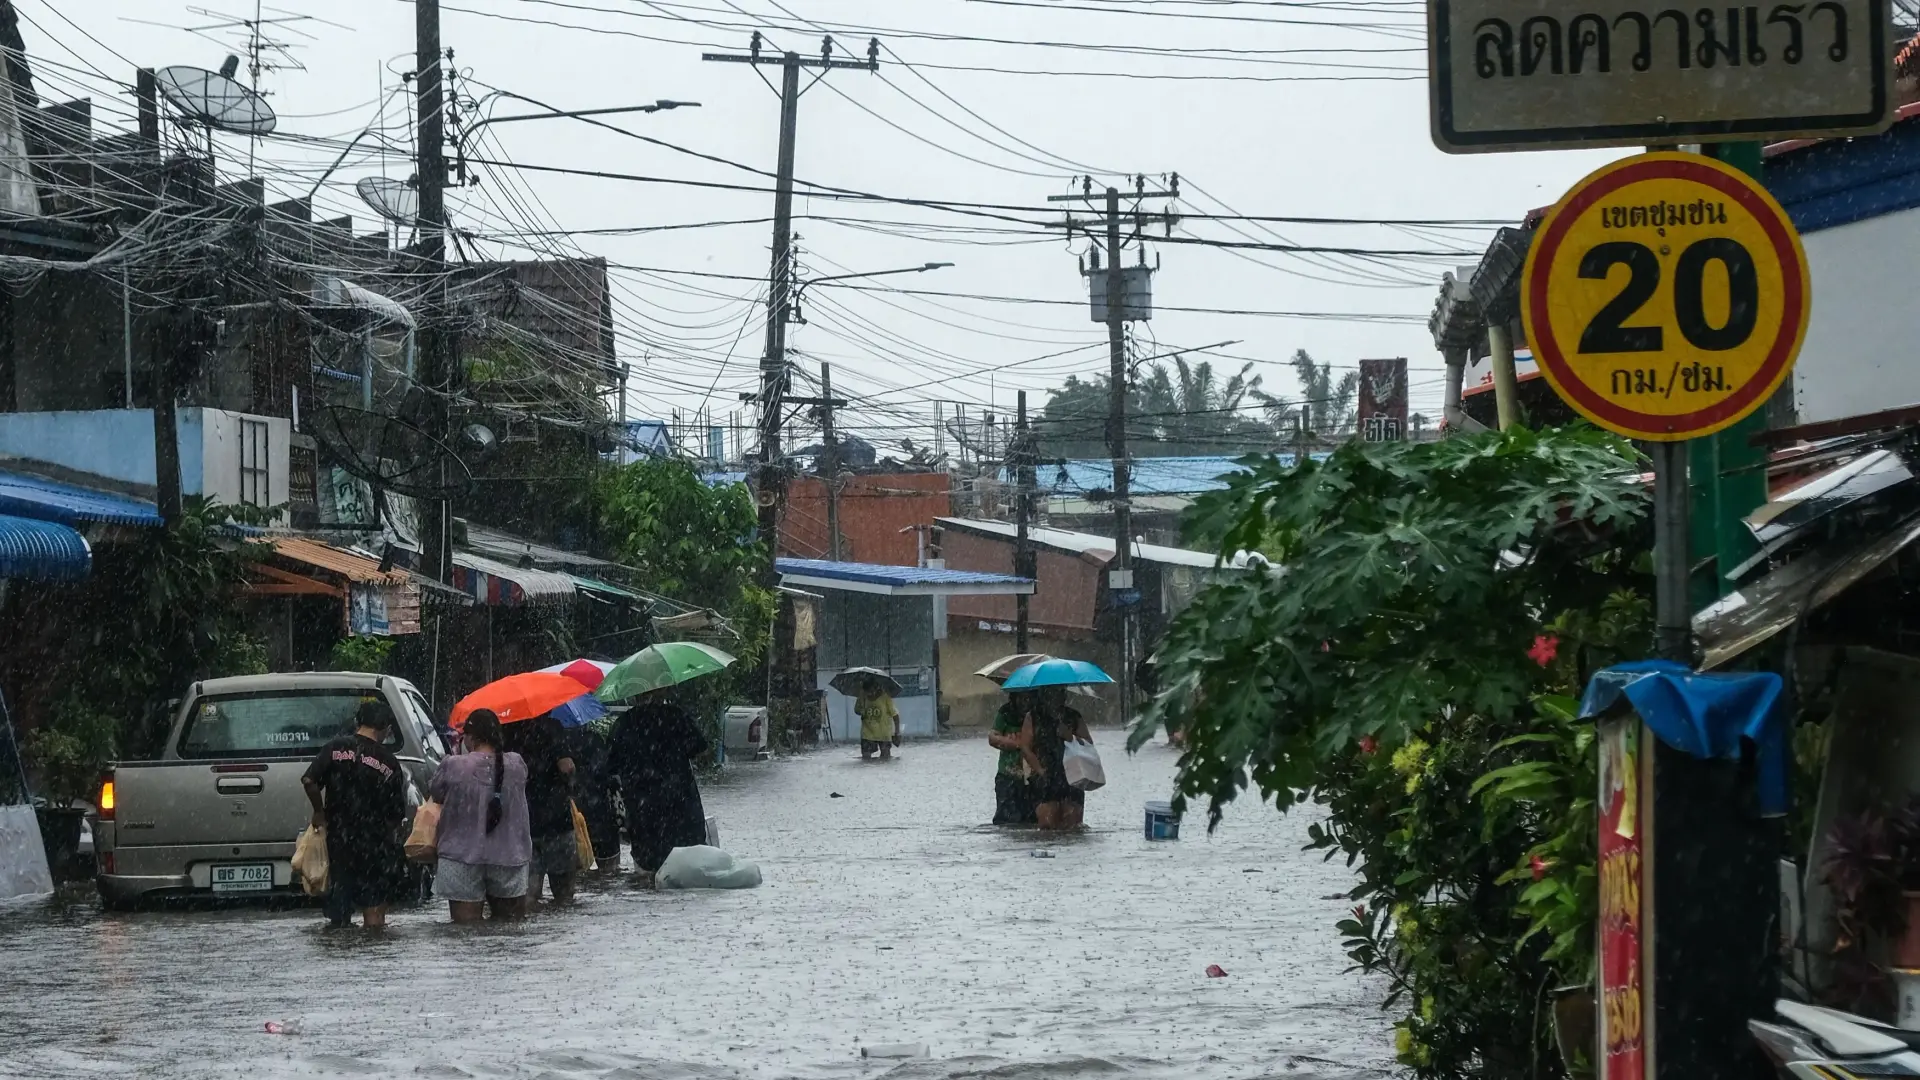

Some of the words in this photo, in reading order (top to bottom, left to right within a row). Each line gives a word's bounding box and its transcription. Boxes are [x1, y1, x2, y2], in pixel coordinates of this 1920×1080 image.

[1473, 0, 1849, 80] ลดความเรว
[1602, 200, 1727, 237] เขตชุมชน
[1577, 237, 1759, 354] 20
[1611, 362, 1732, 399] กม./ชม.
[265, 732, 310, 745] พุทธวจน
[241, 867, 270, 880] 7082
